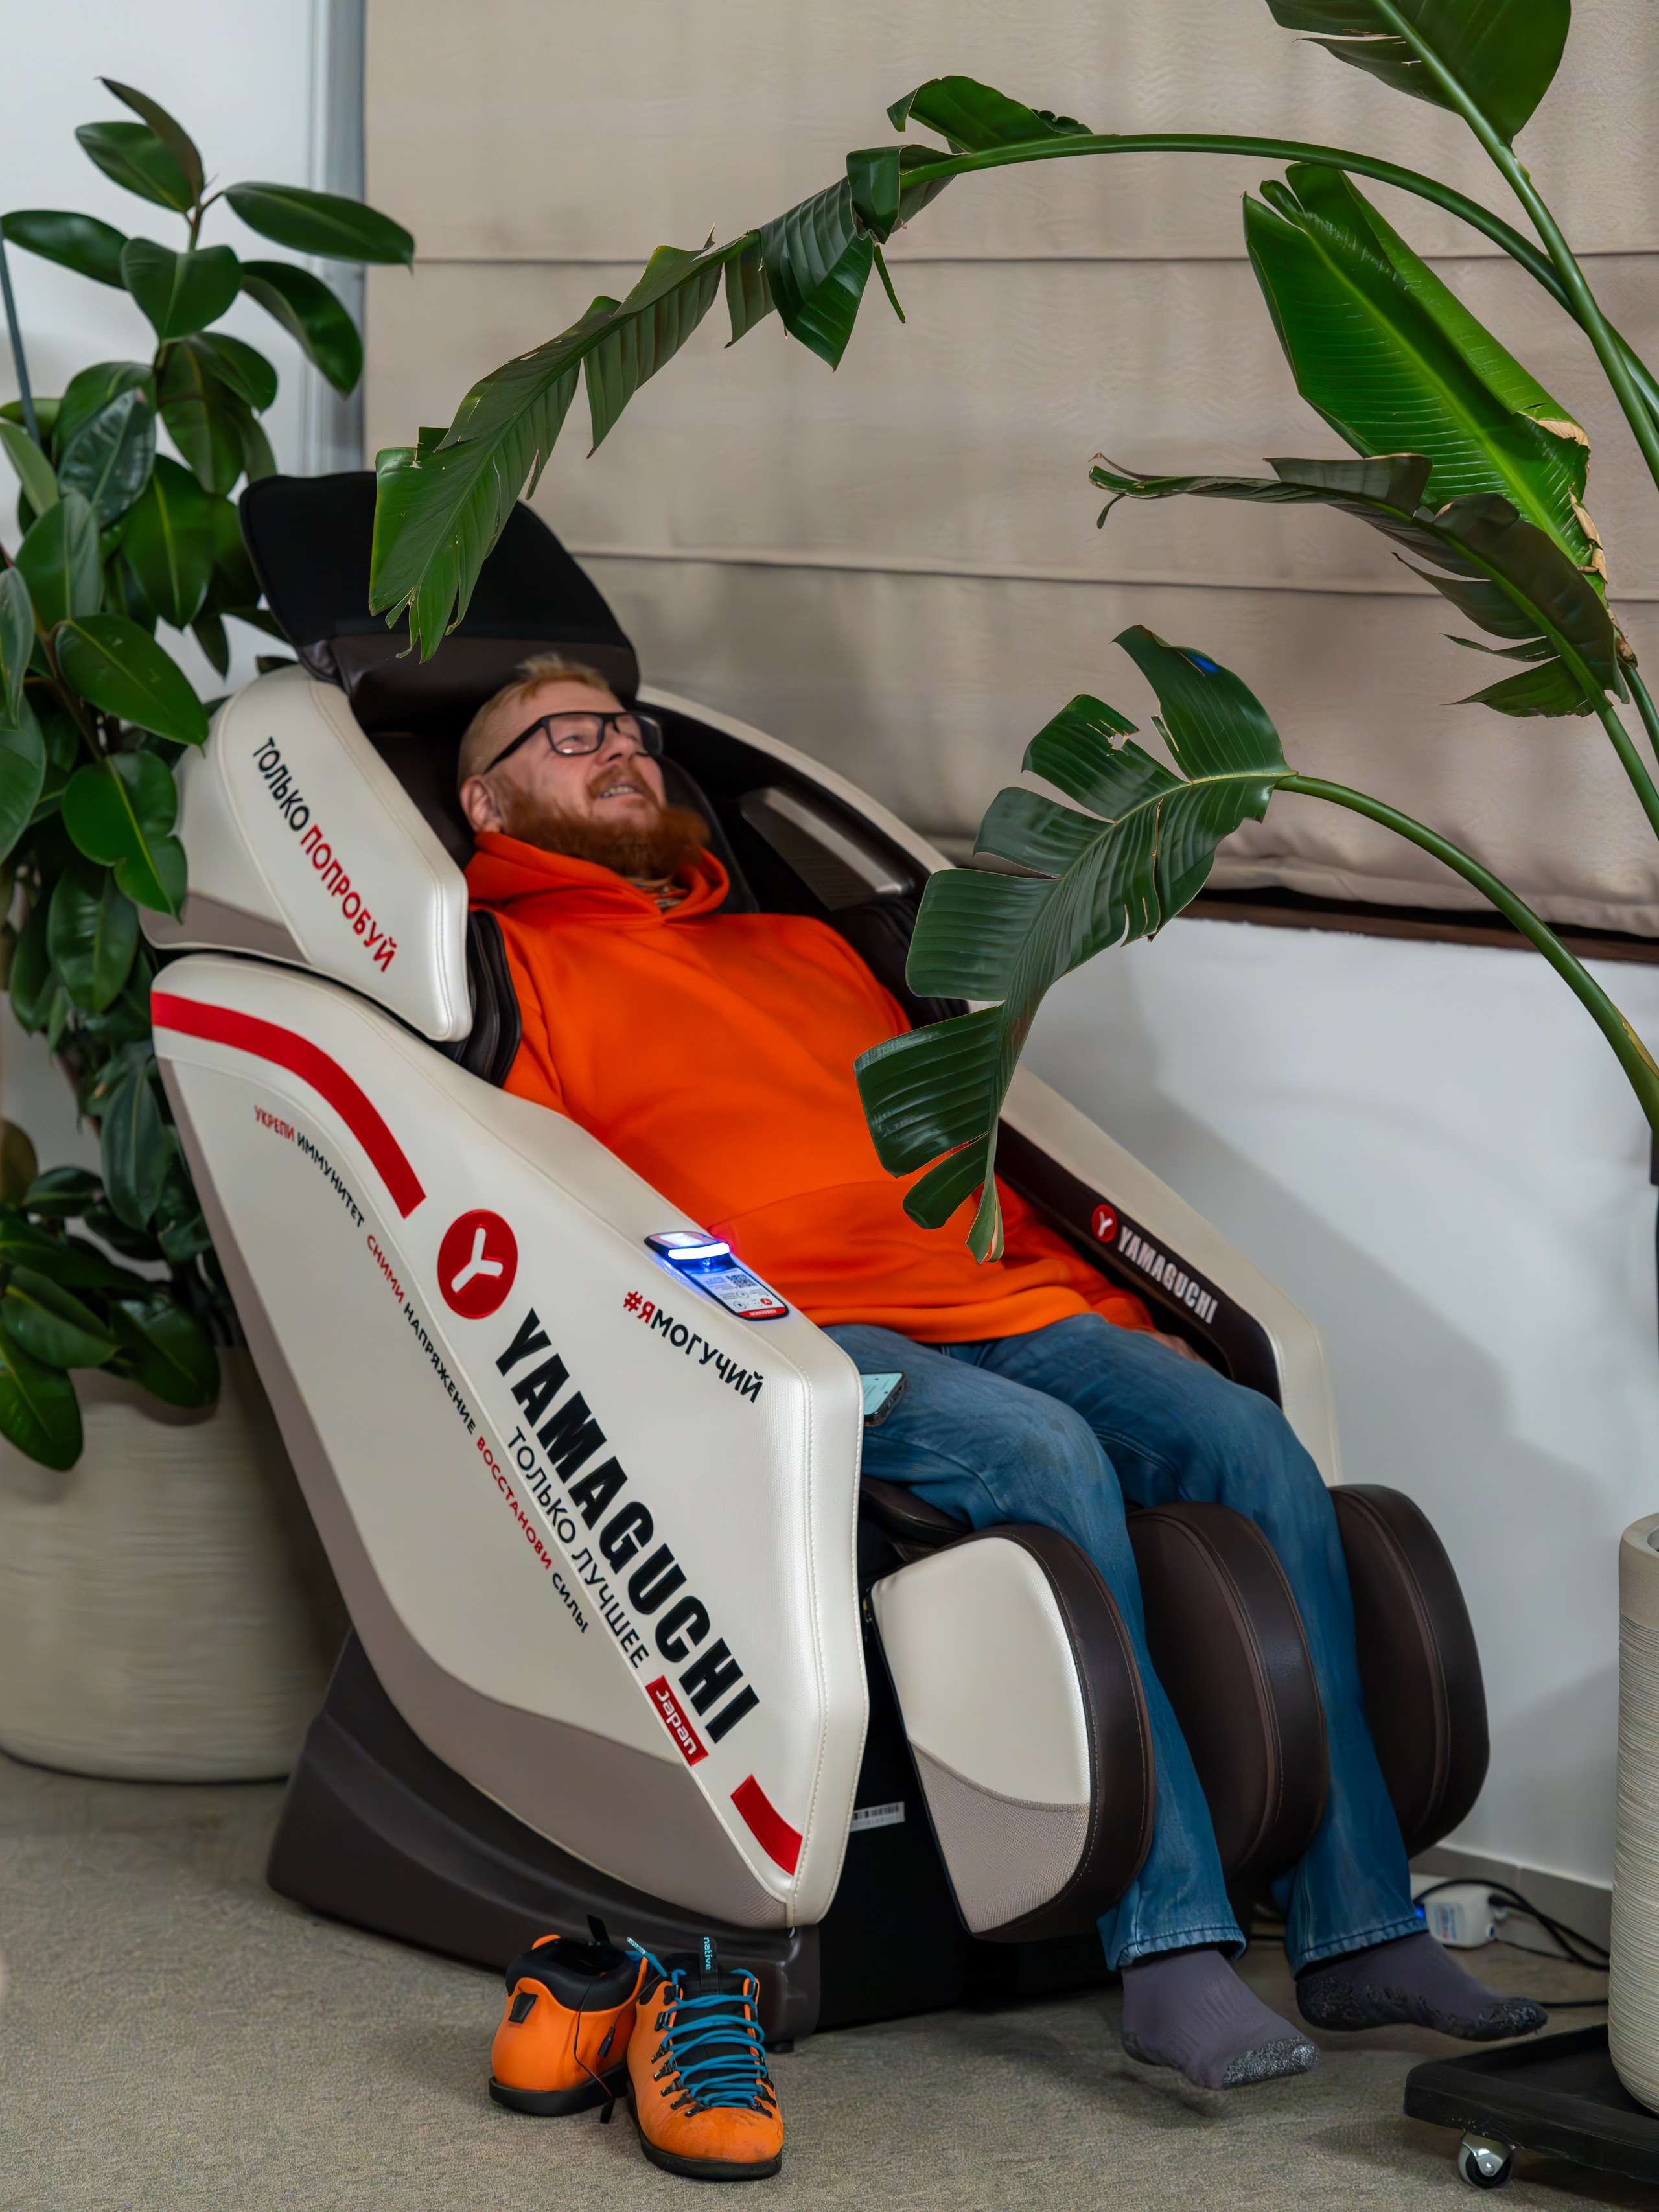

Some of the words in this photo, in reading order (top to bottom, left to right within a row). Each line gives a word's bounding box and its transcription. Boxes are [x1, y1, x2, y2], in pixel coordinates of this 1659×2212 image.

[253, 737, 309, 831] ТОЛЬКО
[300, 824, 397, 972] ПОПРОБУЙ
[623, 1291, 764, 1403] #ЯМОГУЧИЙ
[1117, 1225, 1218, 1325] YAMAGUCHI
[254, 1104, 295, 1142] УКРЕПИ
[297, 1132, 365, 1228] ИММУНИТЕТ
[367, 1234, 405, 1303] СНИМИ
[404, 1302, 476, 1435] НАПРЯЖЕНИЕ
[476, 1436, 553, 1570] ВОССТАНОВИ
[552, 1572, 589, 1633] СИЛЫ
[495, 1307, 760, 1744] YAMAGUCHI
[507, 1426, 575, 1544] ТОЛЬКО
[572, 1547, 649, 1668] ЛУЧШЕЕ
[656, 1690, 697, 1756] Japan
[703, 1937, 713, 1970] native
